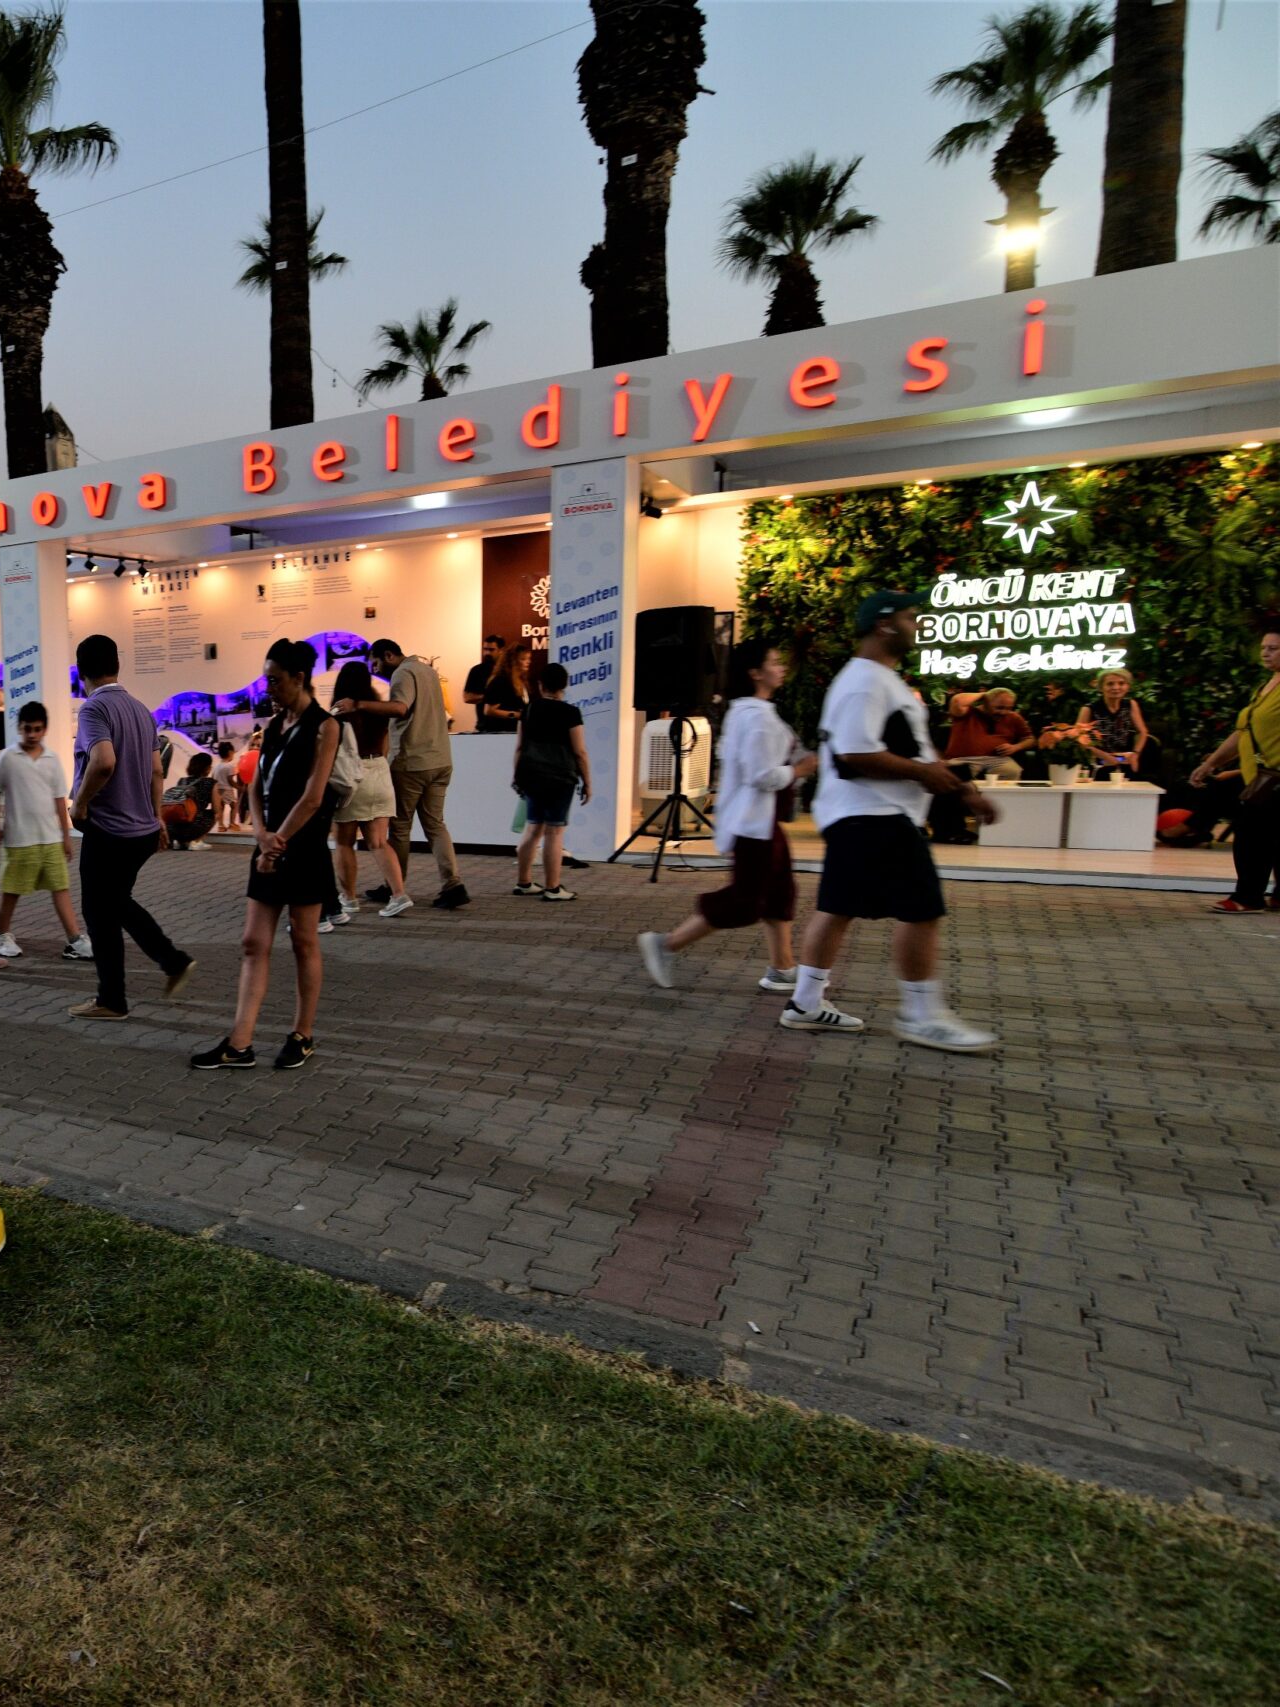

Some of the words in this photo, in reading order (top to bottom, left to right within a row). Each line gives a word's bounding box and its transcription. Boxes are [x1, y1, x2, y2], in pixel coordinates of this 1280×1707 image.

[243, 300, 1048, 493] Belediyesi
[563, 502, 614, 515] BORNOVA
[555, 585, 619, 617] Levanten
[930, 568, 1025, 608] ÖNCÜ
[1028, 567, 1126, 601] KENT
[555, 609, 618, 639] Mirasının
[915, 602, 1136, 644] BORNOVA'YA
[558, 630, 614, 665] Renkli
[919, 648, 979, 679] Hoş
[983, 643, 1128, 673] Geldiniz
[10, 681, 36, 699] Veren
[569, 661, 613, 687] urağı
